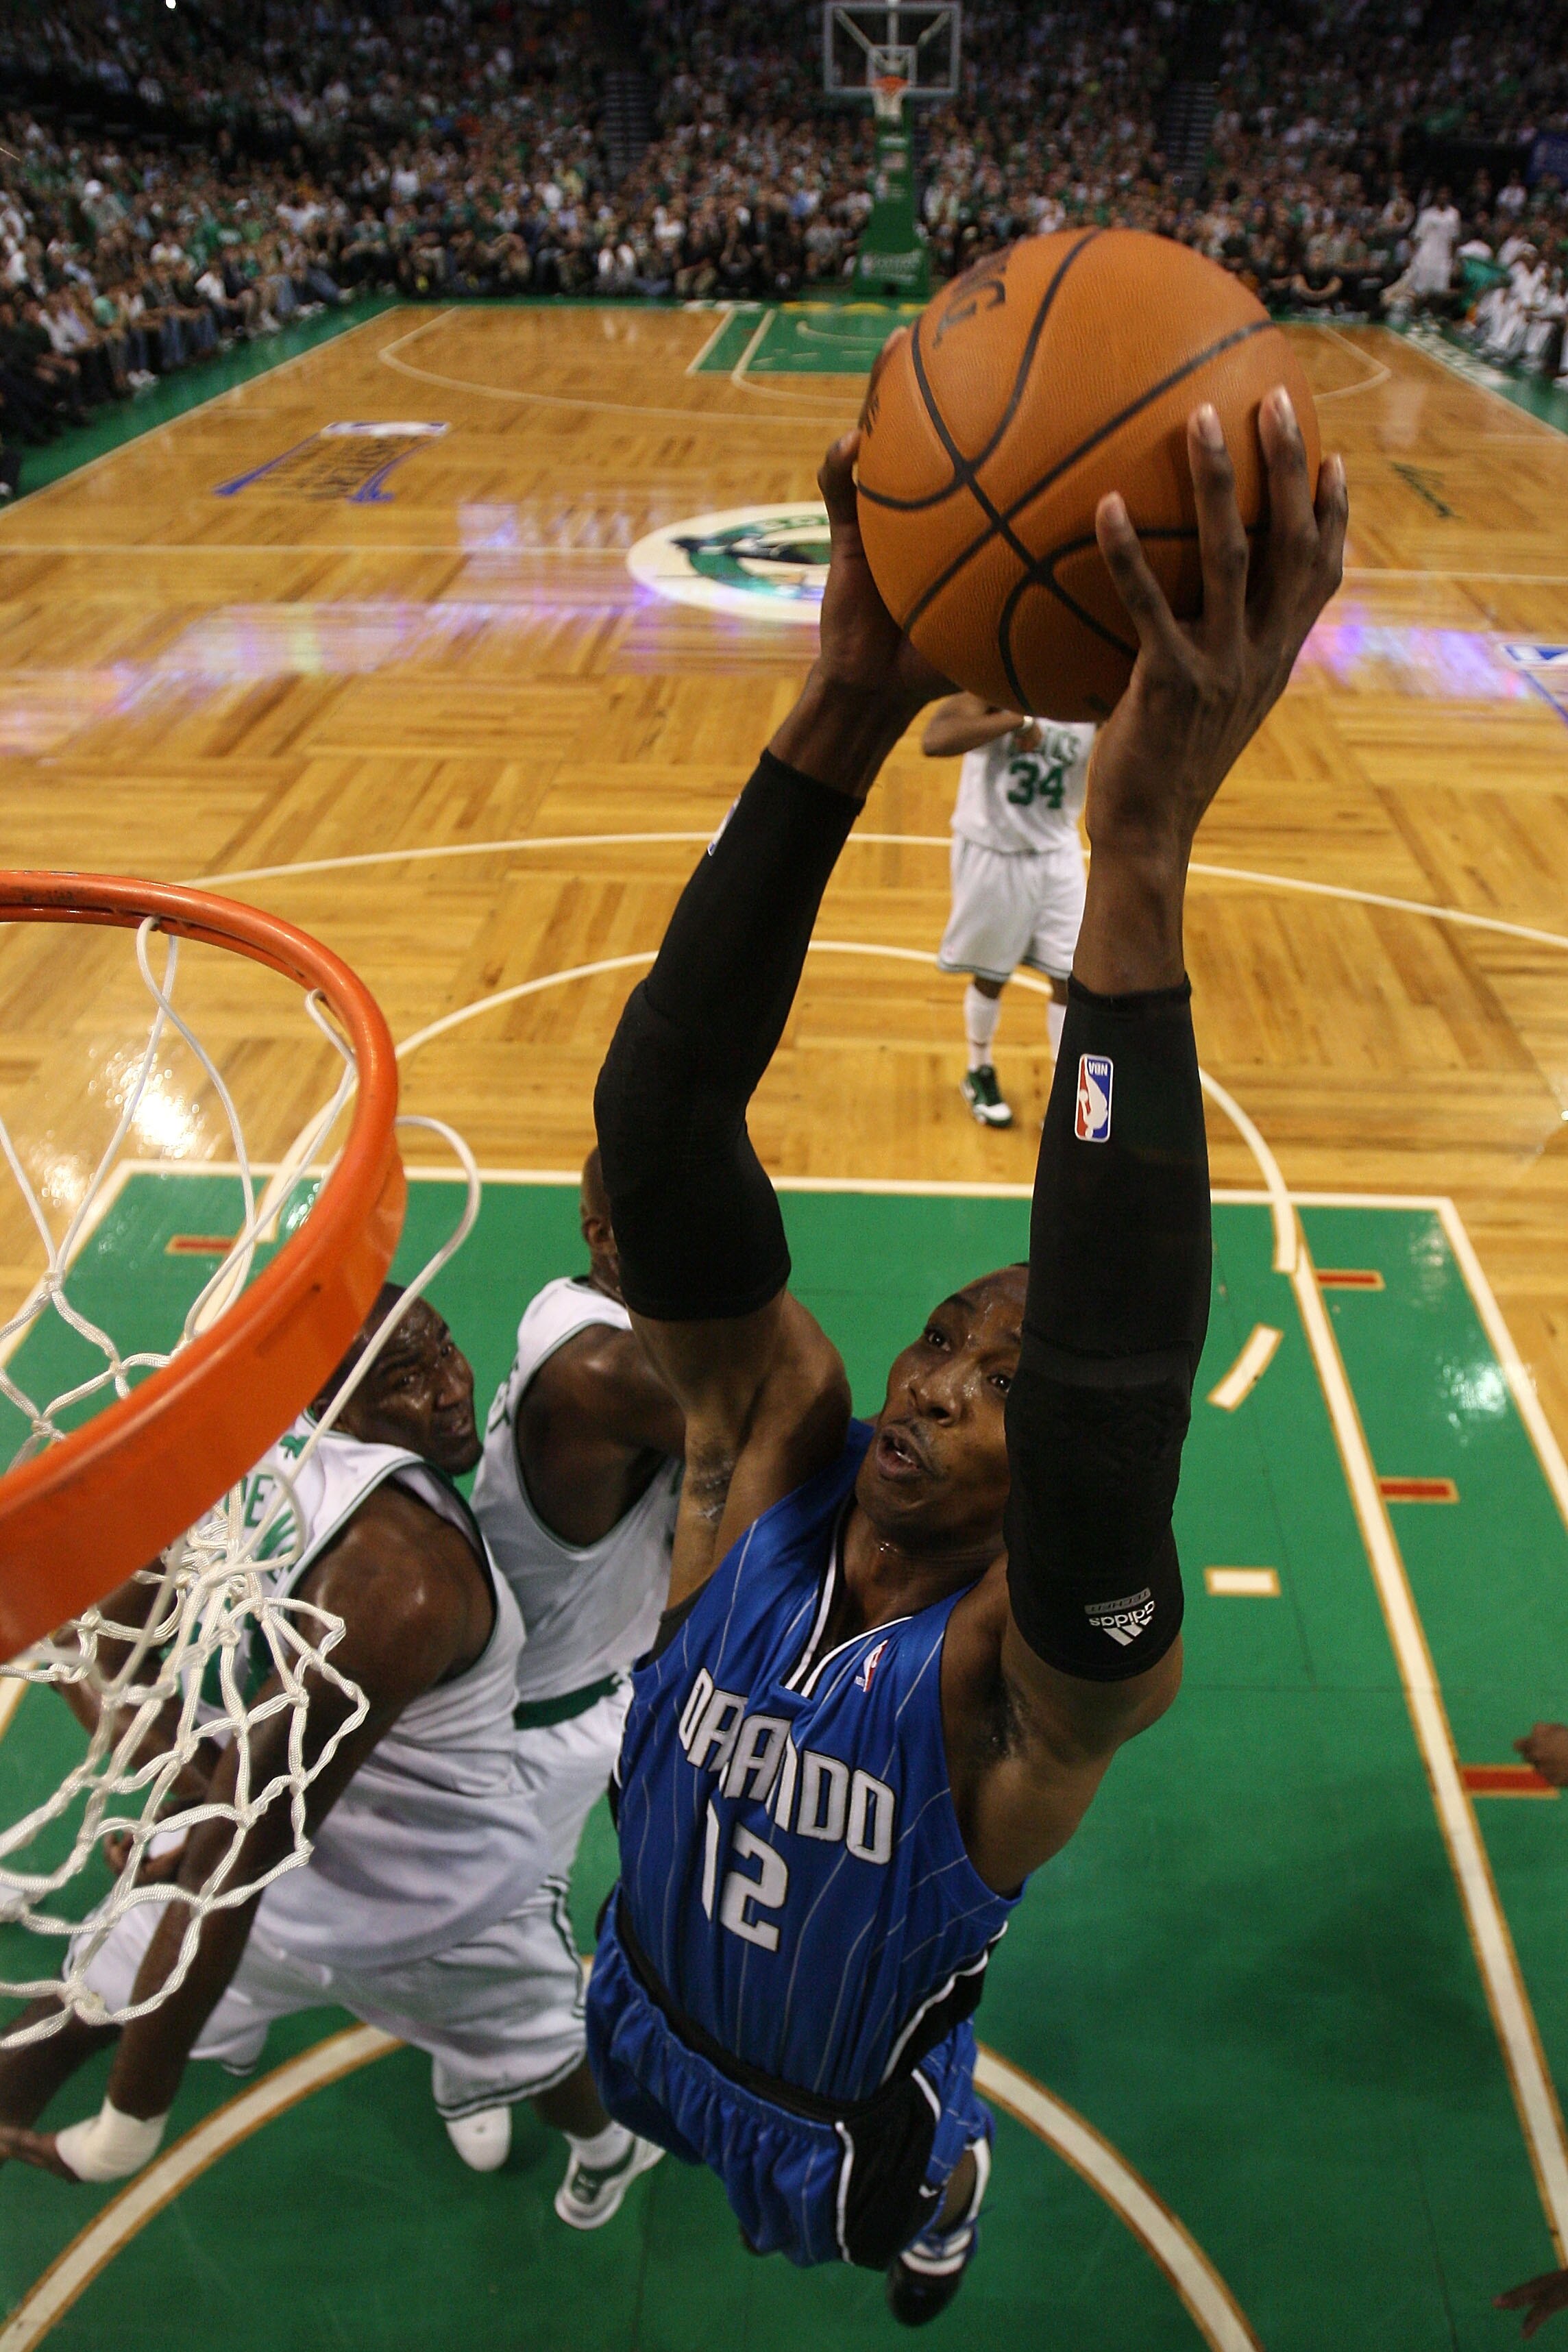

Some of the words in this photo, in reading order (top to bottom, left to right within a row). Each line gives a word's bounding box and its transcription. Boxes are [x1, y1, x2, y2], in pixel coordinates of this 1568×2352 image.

[1007, 759, 1065, 809] 34
[1088, 1060, 1108, 1076] NBA
[1089, 1600, 1156, 1627] adidas
[678, 1668, 895, 1865] ORANDO
[702, 1799, 787, 1952] 12
